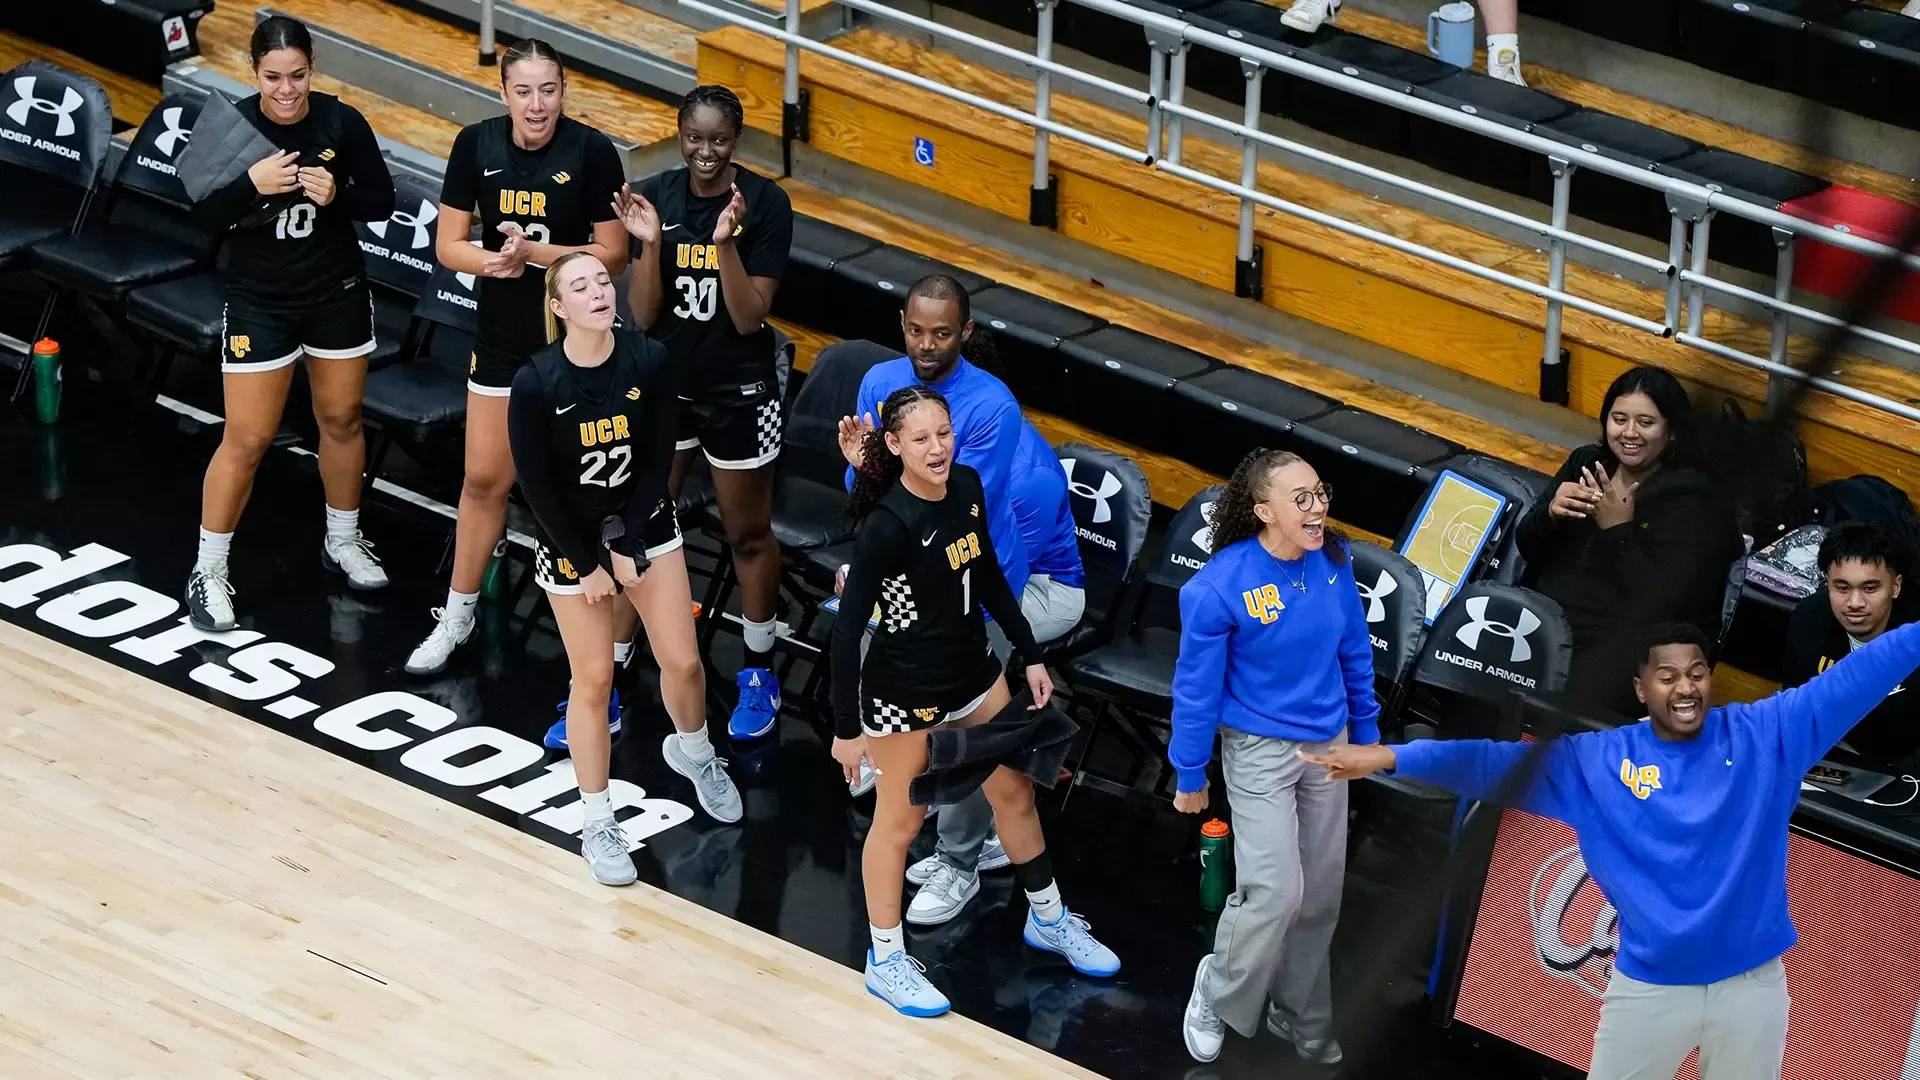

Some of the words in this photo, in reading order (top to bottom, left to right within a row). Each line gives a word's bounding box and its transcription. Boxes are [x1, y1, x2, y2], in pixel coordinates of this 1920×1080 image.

[33, 138, 81, 161] ARMOUR
[136, 155, 177, 176] UNDER
[499, 188, 547, 217] UCR
[275, 203, 317, 239] 10
[391, 251, 433, 273] ARMOUR
[676, 243, 720, 270] UCR
[437, 289, 478, 311] UNDER
[673, 275, 718, 321] 30
[579, 414, 631, 447] UCR
[579, 444, 633, 488] 22
[945, 531, 982, 571] UCR
[557, 557, 579, 580] UC
[962, 568, 971, 616] 1
[1242, 583, 1286, 625] UCR
[1434, 649, 1484, 672] UNDER
[1485, 664, 1537, 689] ARMOUR
[1620, 758, 1663, 801] UCR
